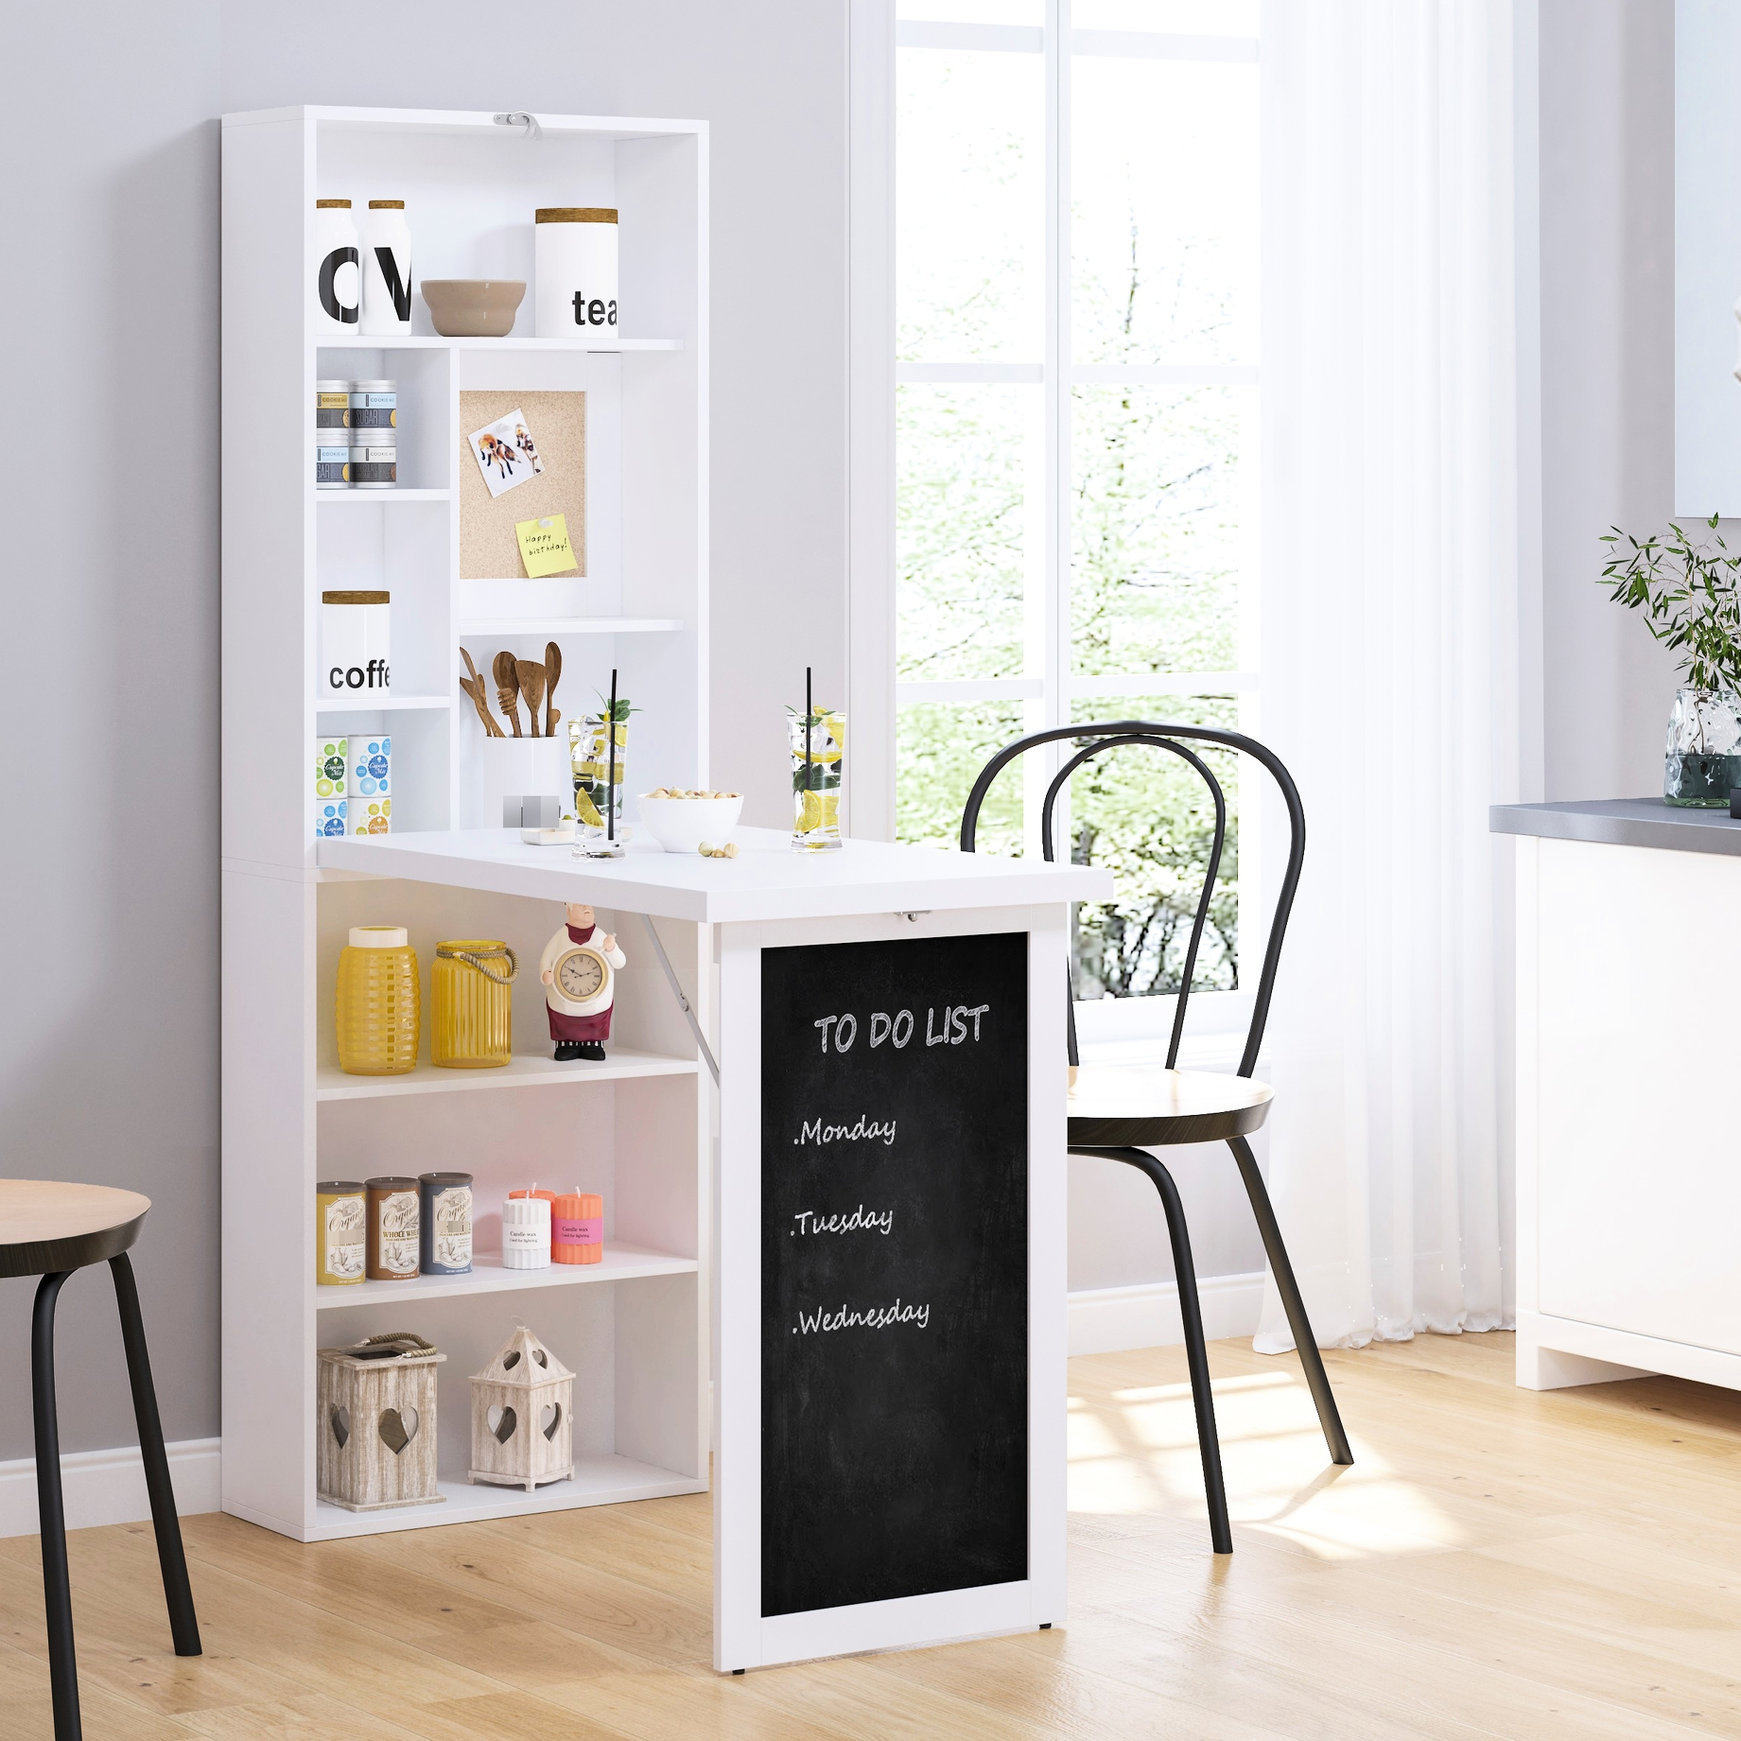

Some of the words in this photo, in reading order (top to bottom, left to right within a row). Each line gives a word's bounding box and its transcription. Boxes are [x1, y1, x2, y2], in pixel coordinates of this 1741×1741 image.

[572, 291, 618, 326] tea
[814, 1013, 857, 1053] TO
[869, 1009, 914, 1049] DO
[925, 1004, 990, 1047] LIST
